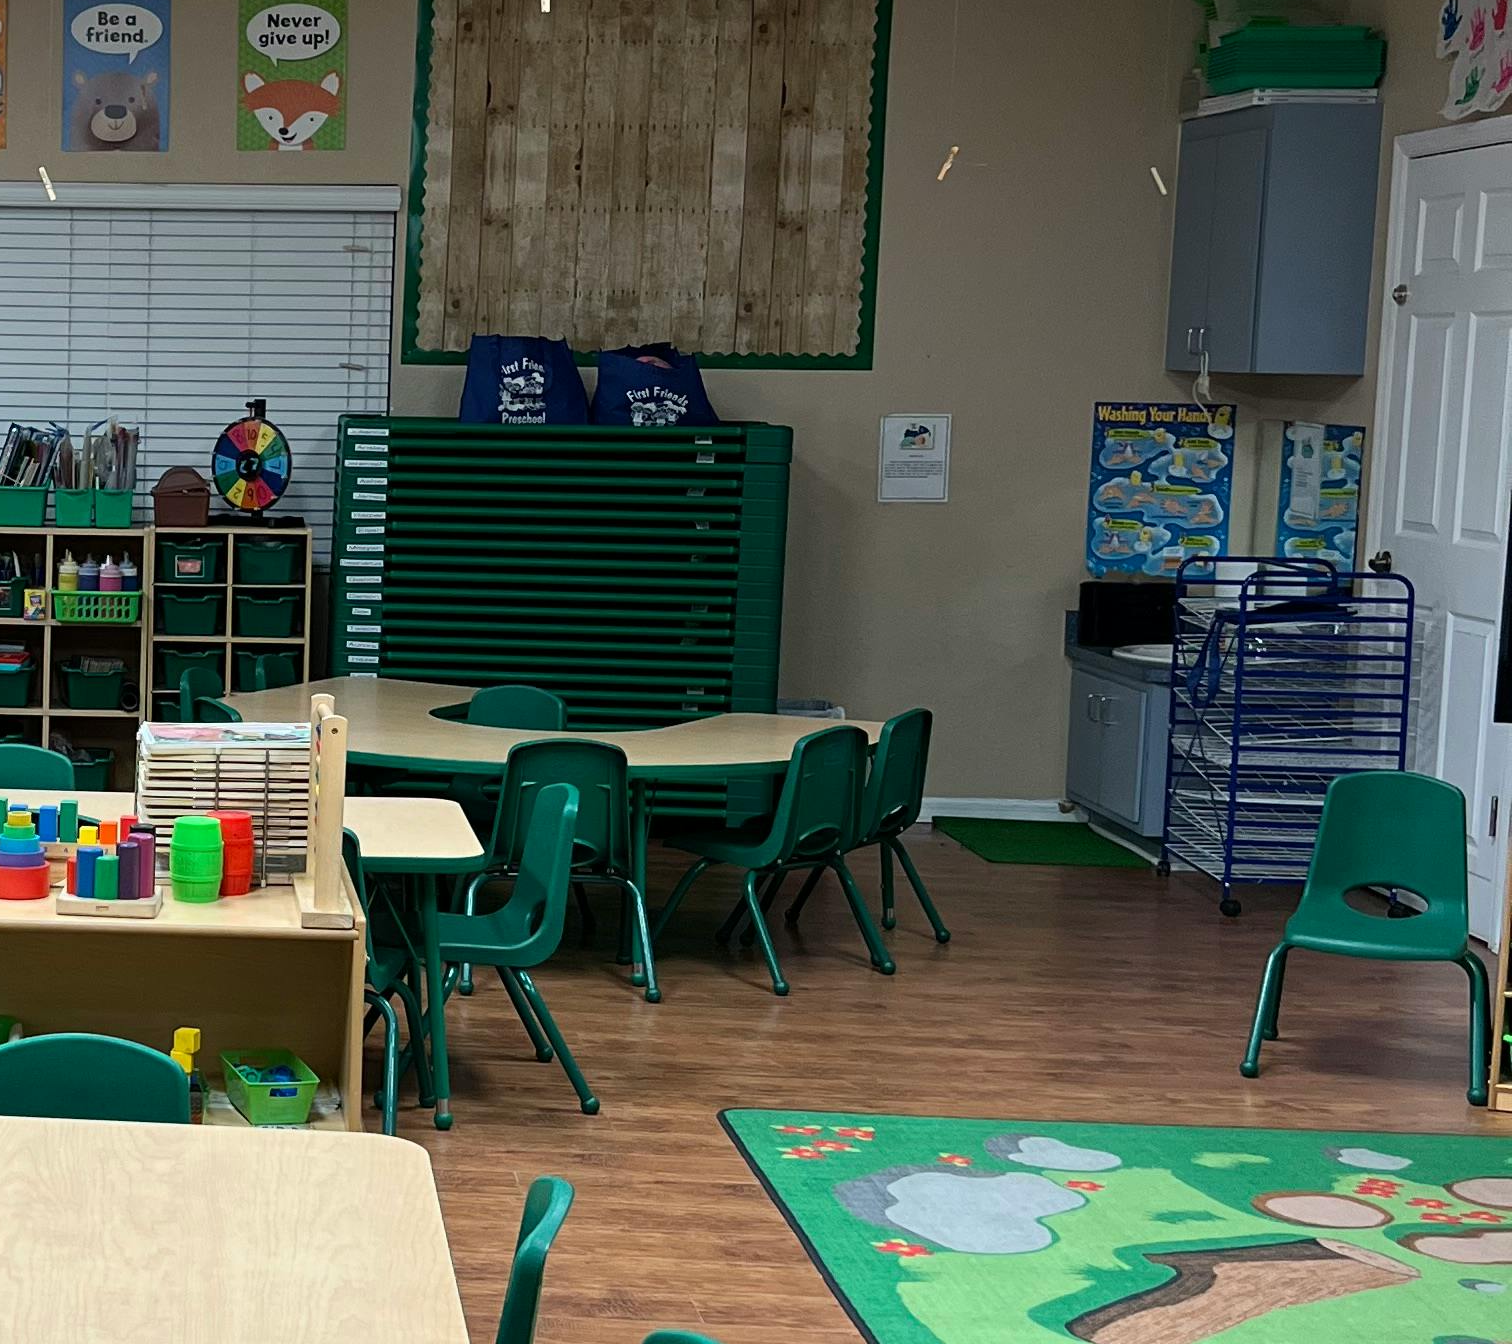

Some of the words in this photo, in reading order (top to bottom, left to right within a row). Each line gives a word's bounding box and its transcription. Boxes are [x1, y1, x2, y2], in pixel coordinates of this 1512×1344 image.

[97, 11, 120, 26] Be
[125, 14, 137, 26] a
[267, 13, 322, 28] Never
[86, 26, 149, 43] friend.
[258, 31, 297, 48] give
[302, 29, 330, 50] up!
[501, 360, 519, 375] irst
[522, 357, 545, 373] Frien
[626, 387, 649, 403] First
[653, 386, 688, 407] Friends
[501, 411, 546, 424] Preschool
[1097, 405, 1147, 425] Washing
[1149, 406, 1176, 422] Your
[247, 429, 257, 441] 10
